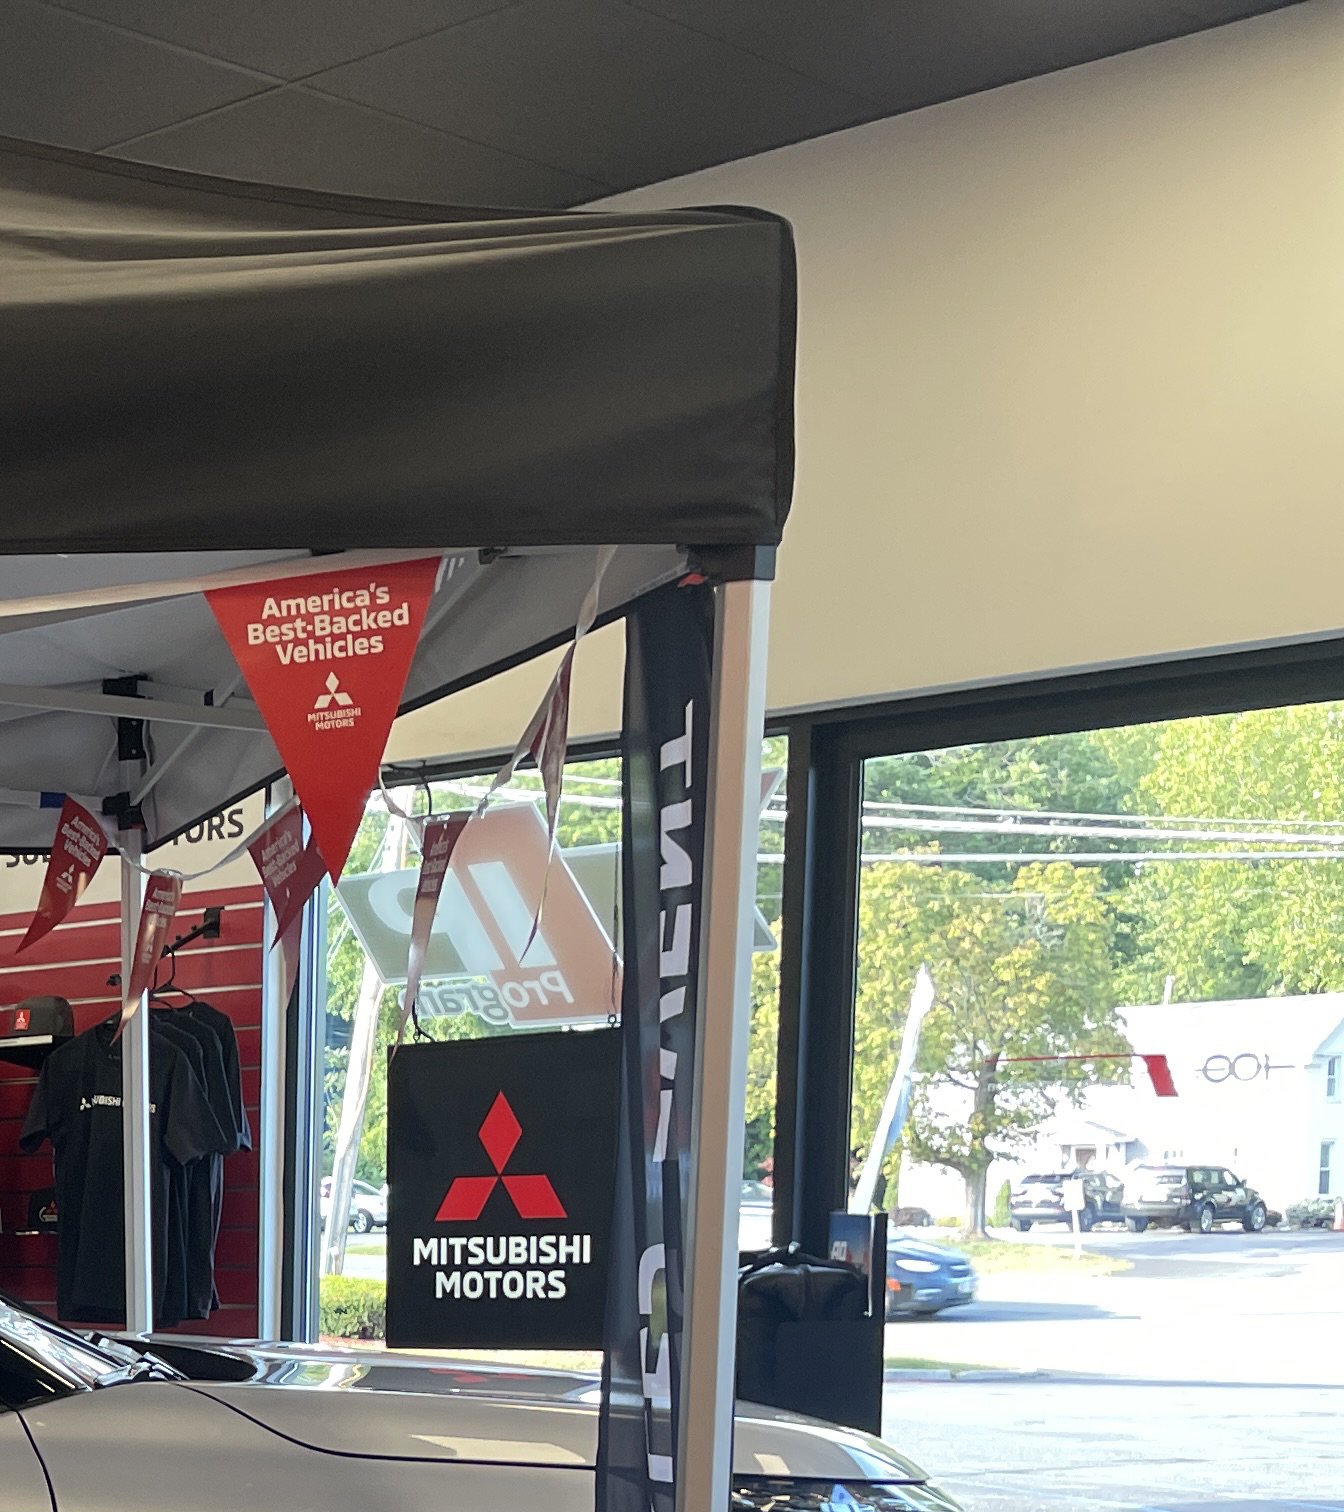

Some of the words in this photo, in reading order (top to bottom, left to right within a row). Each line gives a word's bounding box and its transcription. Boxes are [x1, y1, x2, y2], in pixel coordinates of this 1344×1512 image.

[261, 582, 391, 620] America's
[246, 602, 410, 645] Best-Backed
[274, 634, 384, 665] Vehicles
[307, 707, 362, 722] MITSUBISHI
[315, 718, 354, 731] MOTORS
[413, 1234, 591, 1266] MITSUBISHI
[435, 1270, 567, 1299] MOTORS
